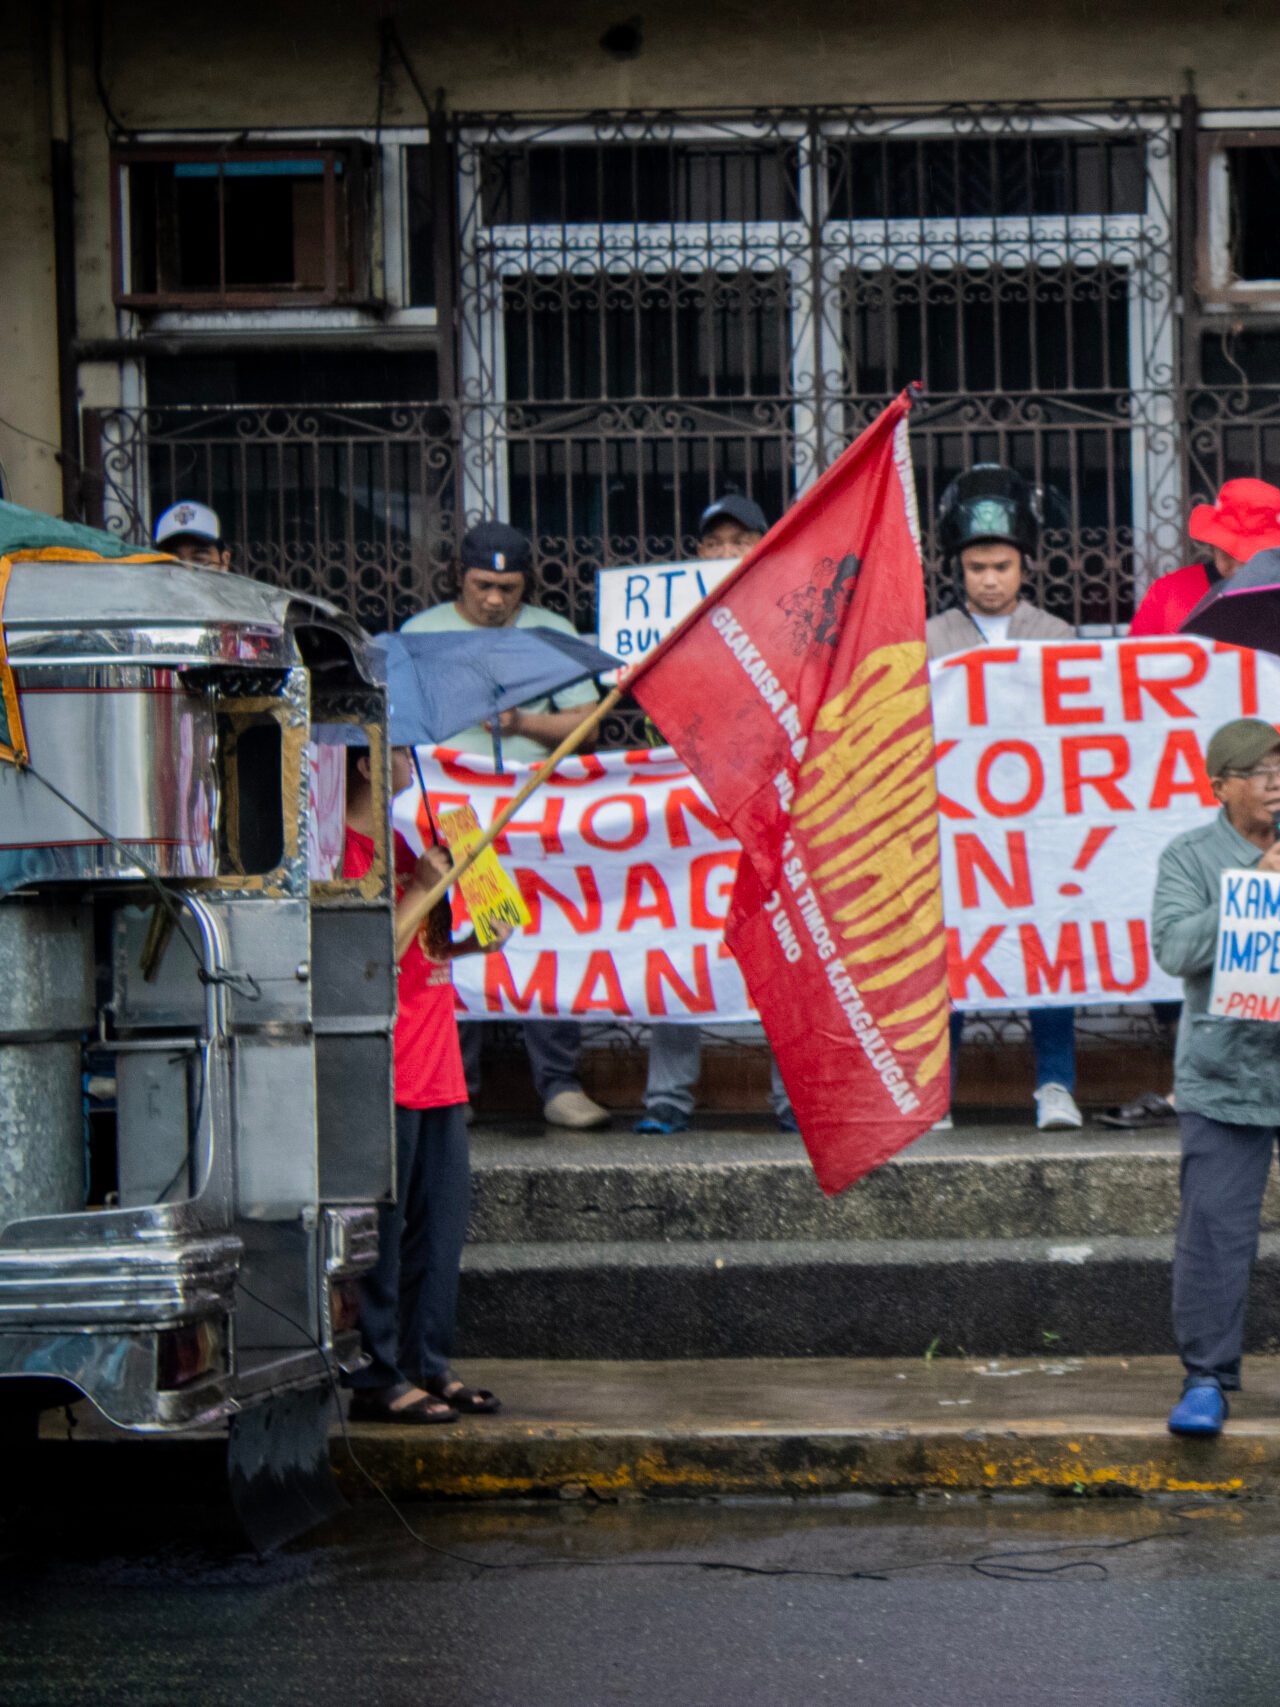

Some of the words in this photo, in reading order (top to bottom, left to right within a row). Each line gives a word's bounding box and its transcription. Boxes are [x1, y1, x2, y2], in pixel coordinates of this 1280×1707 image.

[772, 910, 802, 964] UNO
[783, 857, 807, 892] SA
[797, 888, 836, 960] TIMOG
[825, 959, 920, 1115] KATAGALUGAN
